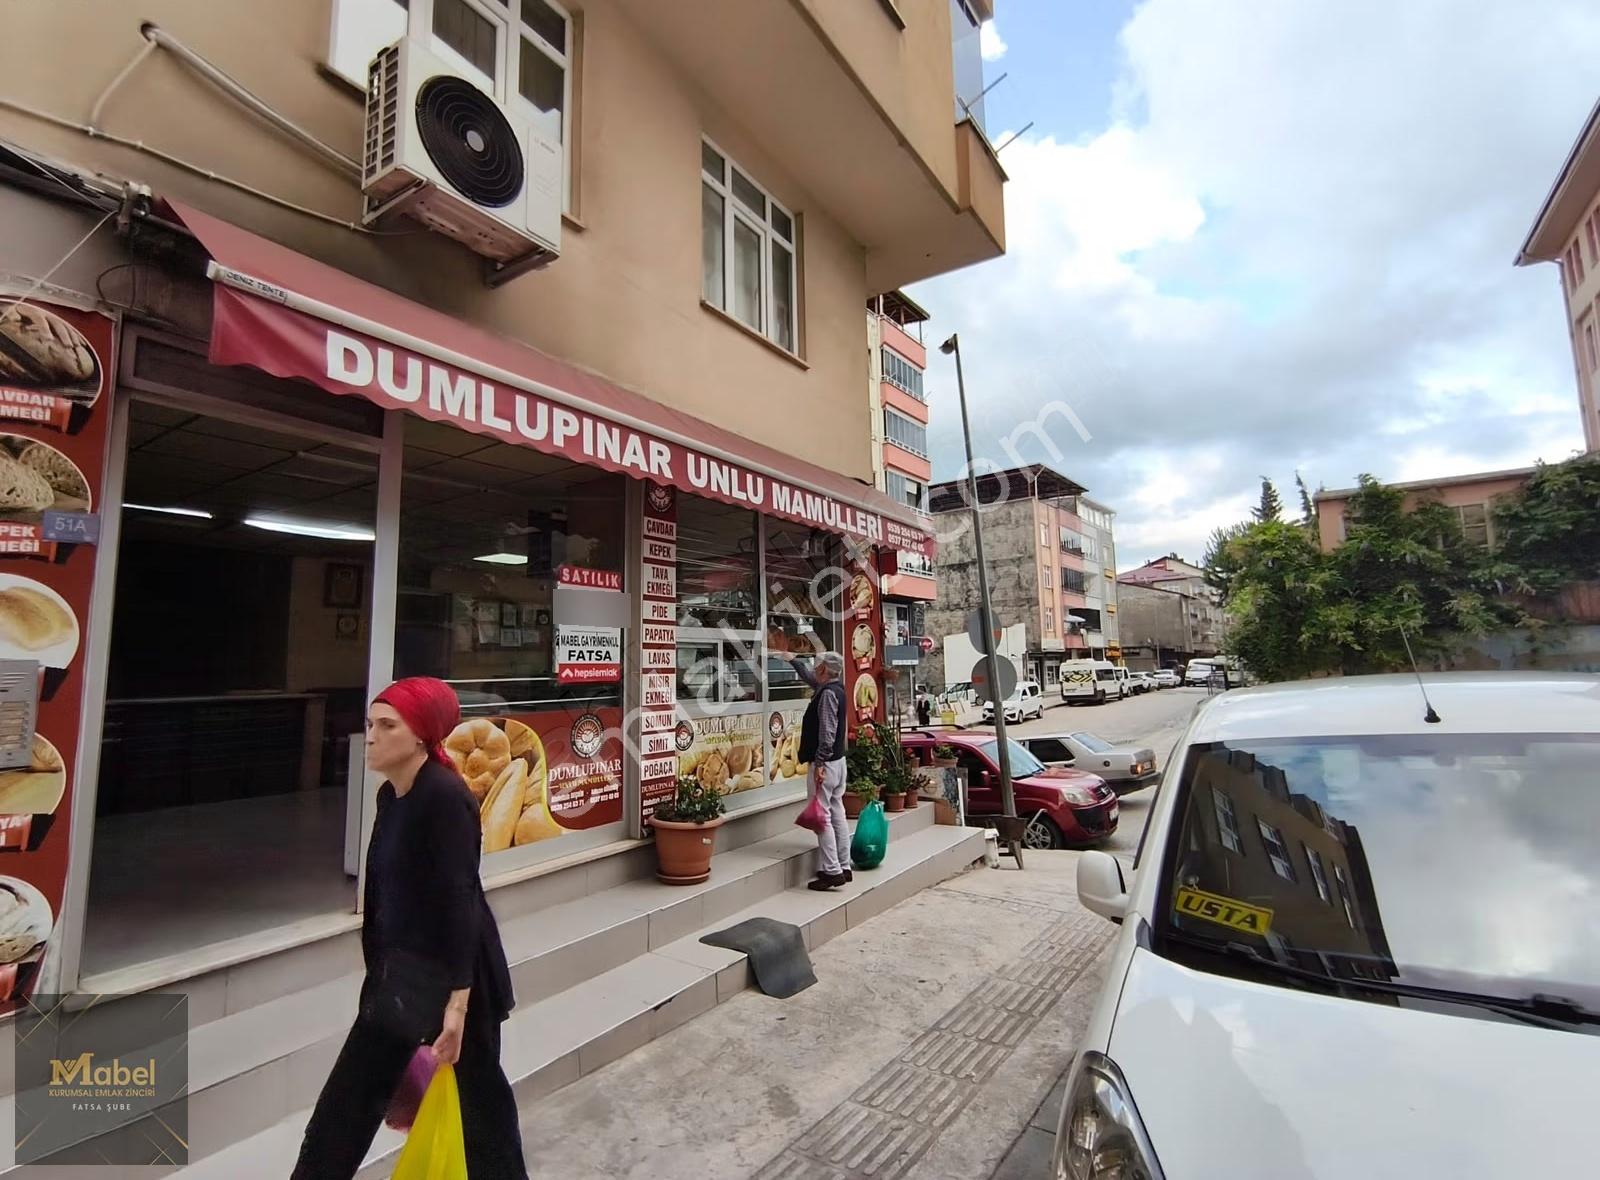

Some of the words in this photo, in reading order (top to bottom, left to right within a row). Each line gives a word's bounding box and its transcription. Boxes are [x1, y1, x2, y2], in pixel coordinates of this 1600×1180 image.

[326, 329, 674, 480] DUMLUPINAR
[686, 452, 764, 505] UNLU
[772, 482, 883, 541] MAMÜLLERİ
[55, 517, 87, 533] 51A
[649, 543, 671, 559] KEPEK
[562, 567, 619, 588] SATILIK
[651, 566, 669, 581] TAVA
[651, 604, 668, 619] PİDE
[560, 634, 581, 647] MABEL
[644, 627, 675, 643] PAPATYA
[568, 649, 612, 662] FATSA
[648, 651, 671, 666] LAVAŞ
[574, 667, 618, 679] hepsiemlak
[645, 713, 673, 730] SOMUN
[695, 713, 762, 735] DUMLUPINAR
[548, 758, 622, 782] DUMLUPINAR
[1182, 895, 1258, 929] USTA
